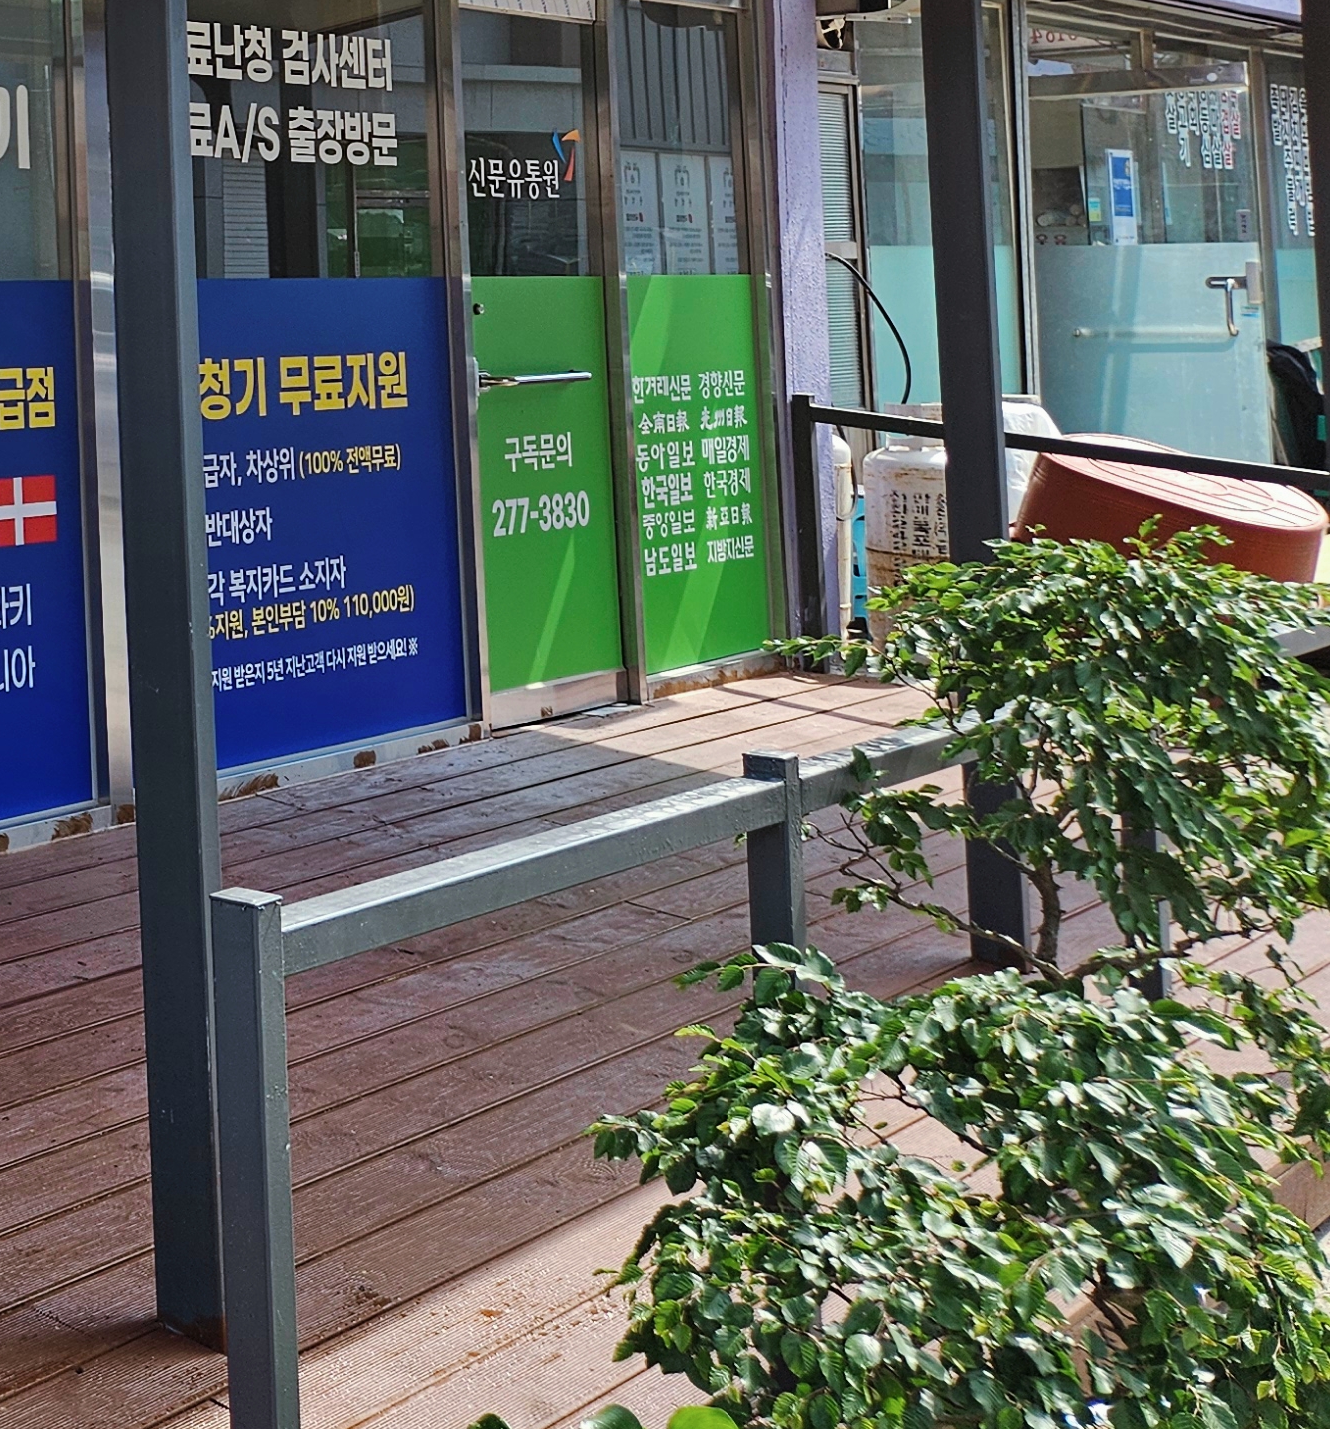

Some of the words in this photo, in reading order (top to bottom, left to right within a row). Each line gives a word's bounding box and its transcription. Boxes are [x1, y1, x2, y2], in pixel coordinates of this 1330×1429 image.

[281, 29, 394, 92] 검사센터
[287, 106, 398, 167] 출장방문
[468, 156, 561, 201] 신문유통원
[279, 351, 409, 416] 무료지원
[632, 374, 692, 405] 한겨레신문
[698, 370, 745, 399] 경향신문
[245, 447, 296, 484] 차상위
[346, 443, 402, 475] 전액무료)
[504, 431, 573, 473] 구독문의
[635, 440, 696, 473] 동아일보
[701, 434, 750, 465] 매일경제
[641, 472, 693, 509] 한국일보
[703, 467, 751, 499] 한국경제
[205, 506, 274, 548] 반대상자
[492, 489, 590, 538] 277-3830
[642, 509, 696, 541] 중앙일보
[644, 541, 698, 577] 남도일보
[706, 535, 755, 564] 지방지신문
[228, 563, 296, 604] 복지카드
[298, 554, 347, 591] 소지자
[251, 599, 307, 636] 본인부담
[309, 597, 341, 624] 10%
[343, 585, 415, 619] 110,000원)
[211, 665, 233, 692] 지원
[326, 646, 347, 671] 다시
[347, 642, 367, 667] 지원
